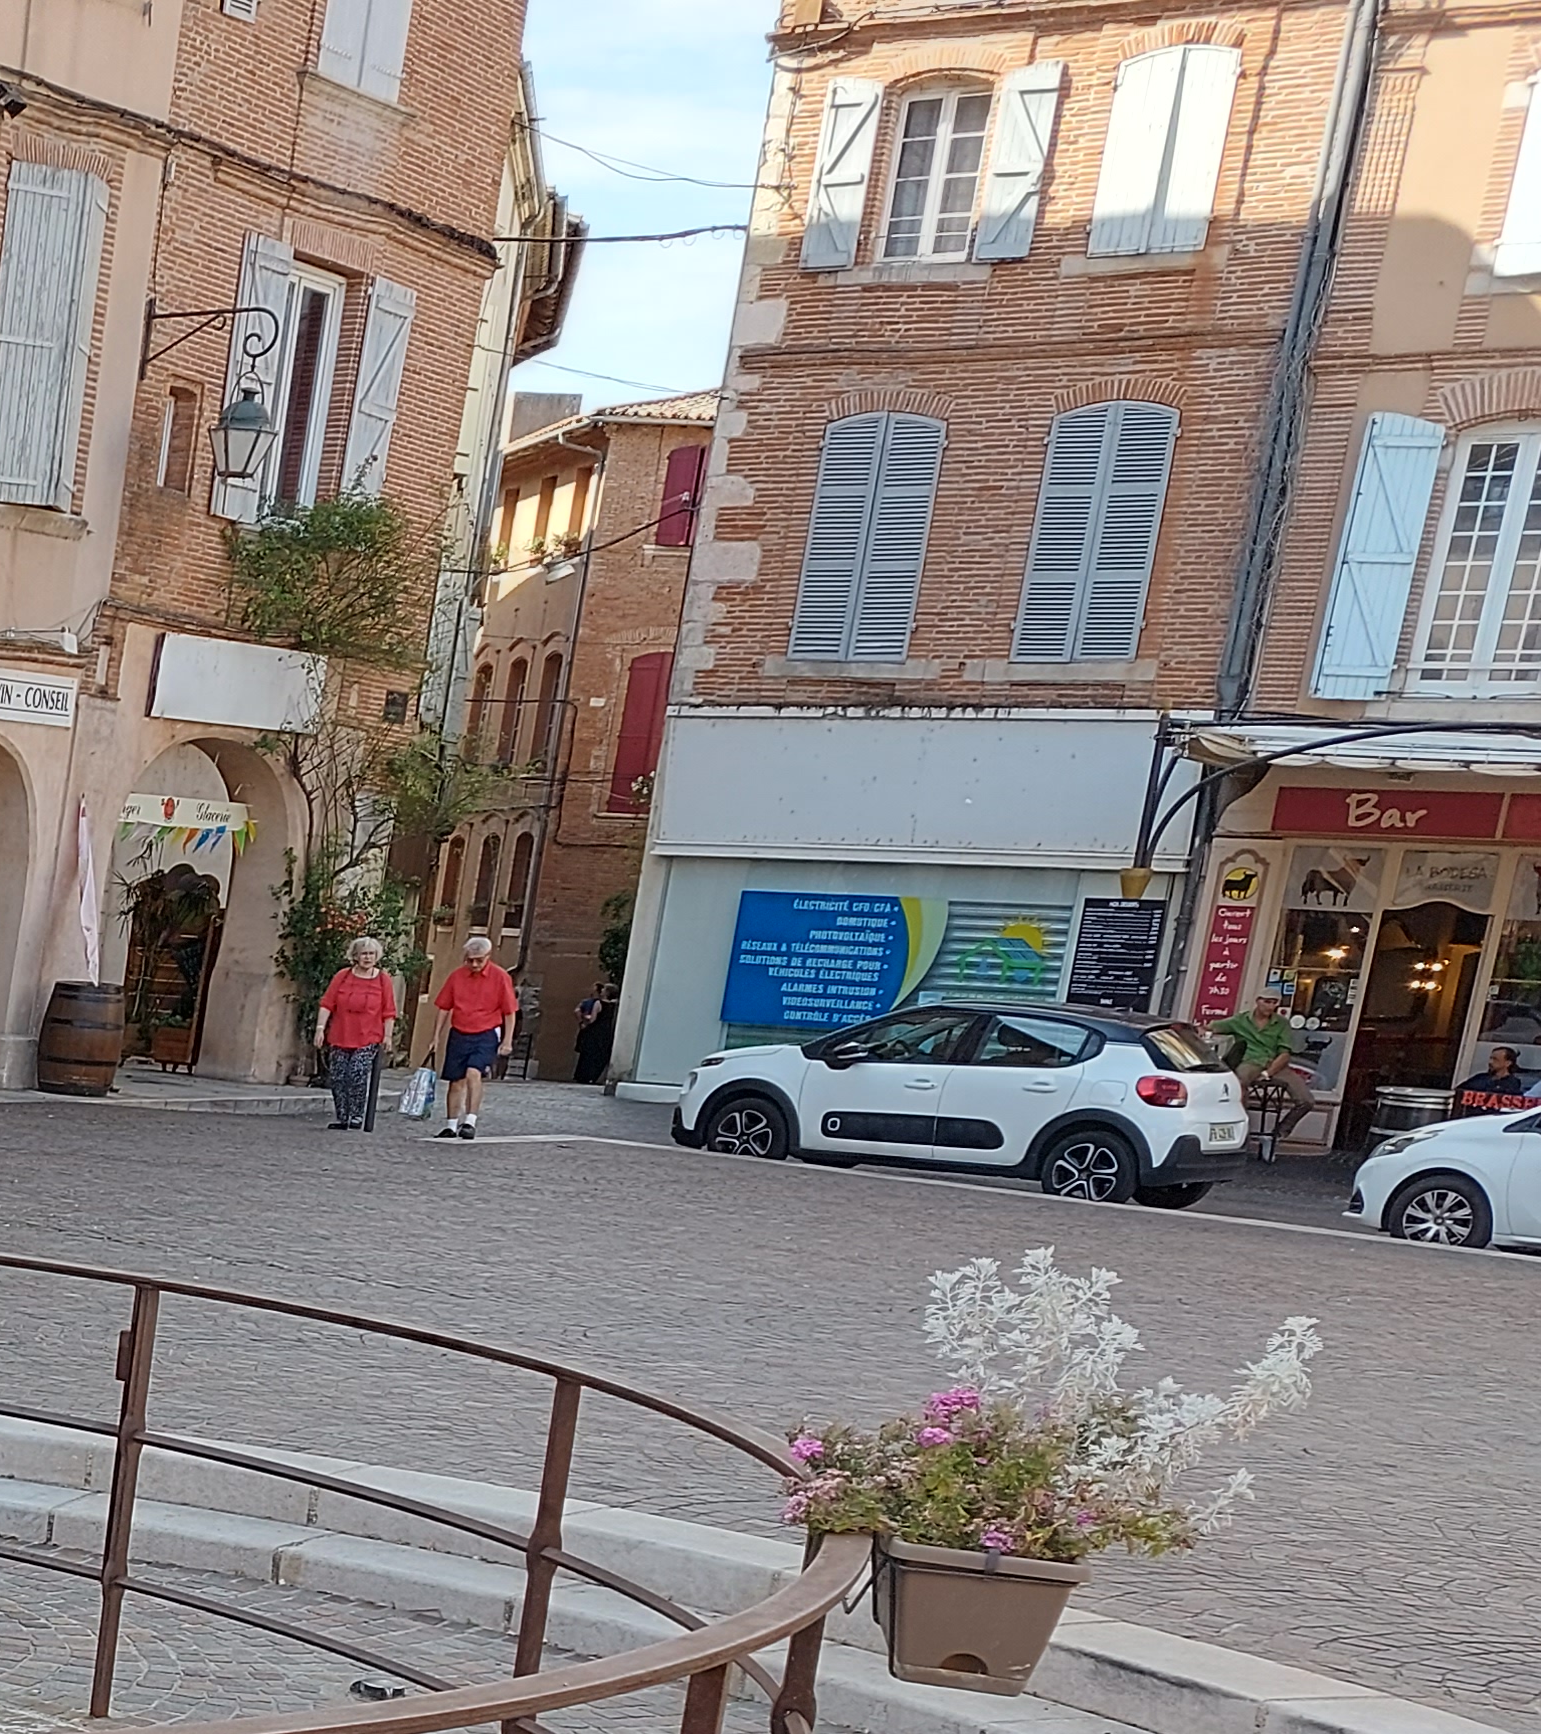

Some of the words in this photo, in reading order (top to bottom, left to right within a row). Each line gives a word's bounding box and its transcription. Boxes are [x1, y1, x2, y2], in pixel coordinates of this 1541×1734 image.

[24, 687, 69, 712] CONSEIL
[1345, 793, 1428, 828] Bar
[793, 898, 849, 912] ÉLECTRICITÉ
[836, 916, 889, 929] DOMOTIQUE
[809, 930, 886, 943] PHOTOVOLTAÏQUE
[1222, 934, 1248, 945] jours
[741, 939, 778, 951] RÉSEAUX
[791, 941, 884, 957] TÉLÉCOMMUNICATIONS
[739, 954, 788, 966] SOLUTIONS
[791, 957, 802, 966] DE
[806, 958, 853, 970] RECHARGE
[856, 960, 882, 971] POUR
[768, 966, 816, 979] VÉHICULES
[819, 968, 880, 982] ÉLECTRIQUES
[780, 982, 824, 994] ALARMES
[826, 985, 877, 996] INTRUSION
[783, 1010, 829, 1022] CONTRÔLE
[1461, 1090, 1541, 1110] BRASSE
